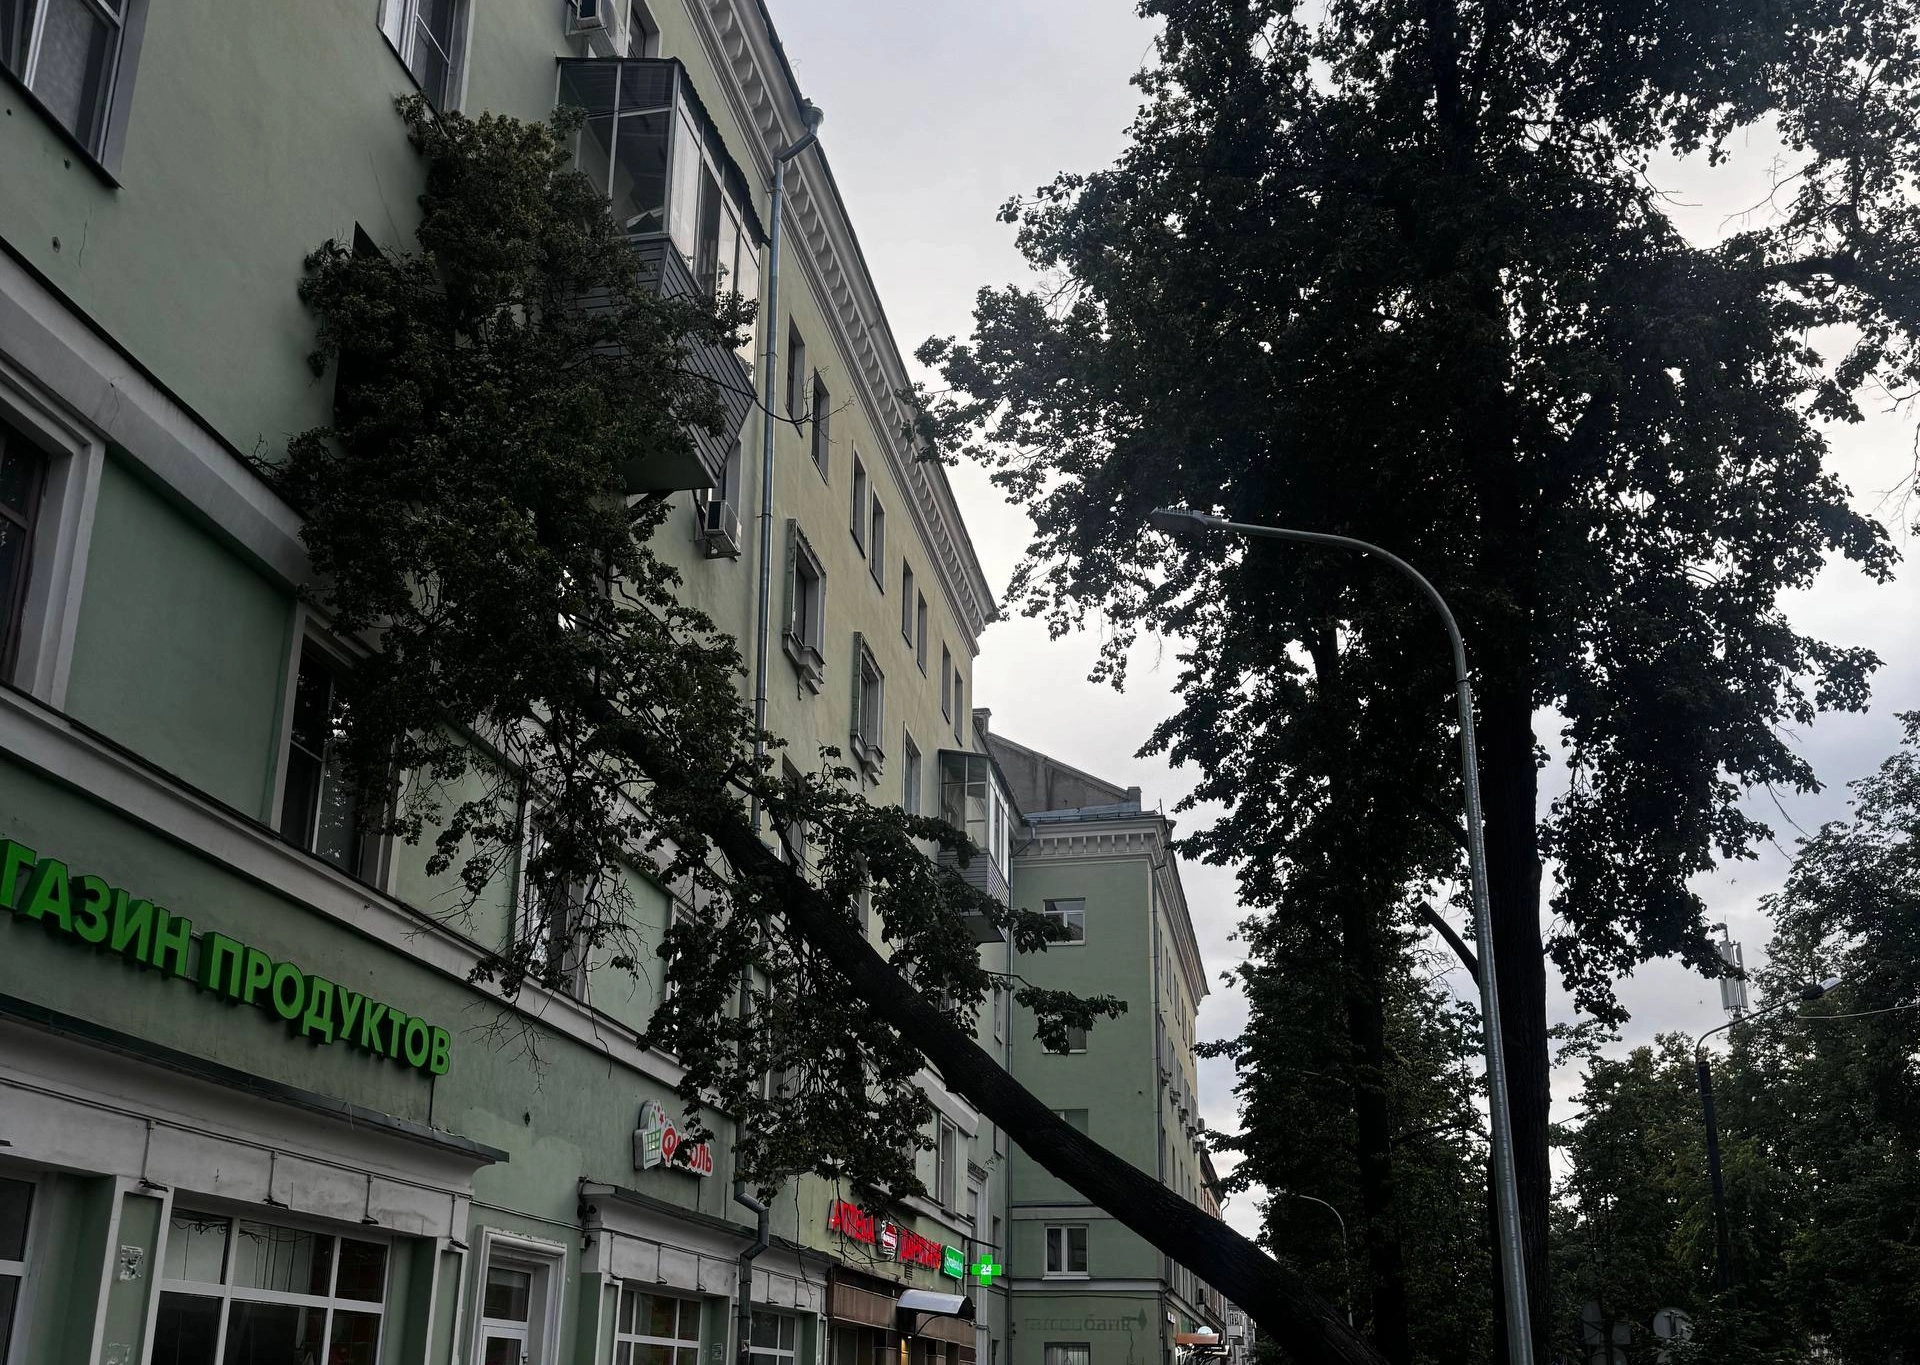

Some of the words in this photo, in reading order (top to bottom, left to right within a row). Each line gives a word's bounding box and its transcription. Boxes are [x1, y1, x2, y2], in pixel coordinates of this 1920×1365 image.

[0, 839, 192, 978] ГАЗИН
[203, 931, 451, 1075] ПРОДУКТОВ
[980, 1264, 992, 1273] 24
